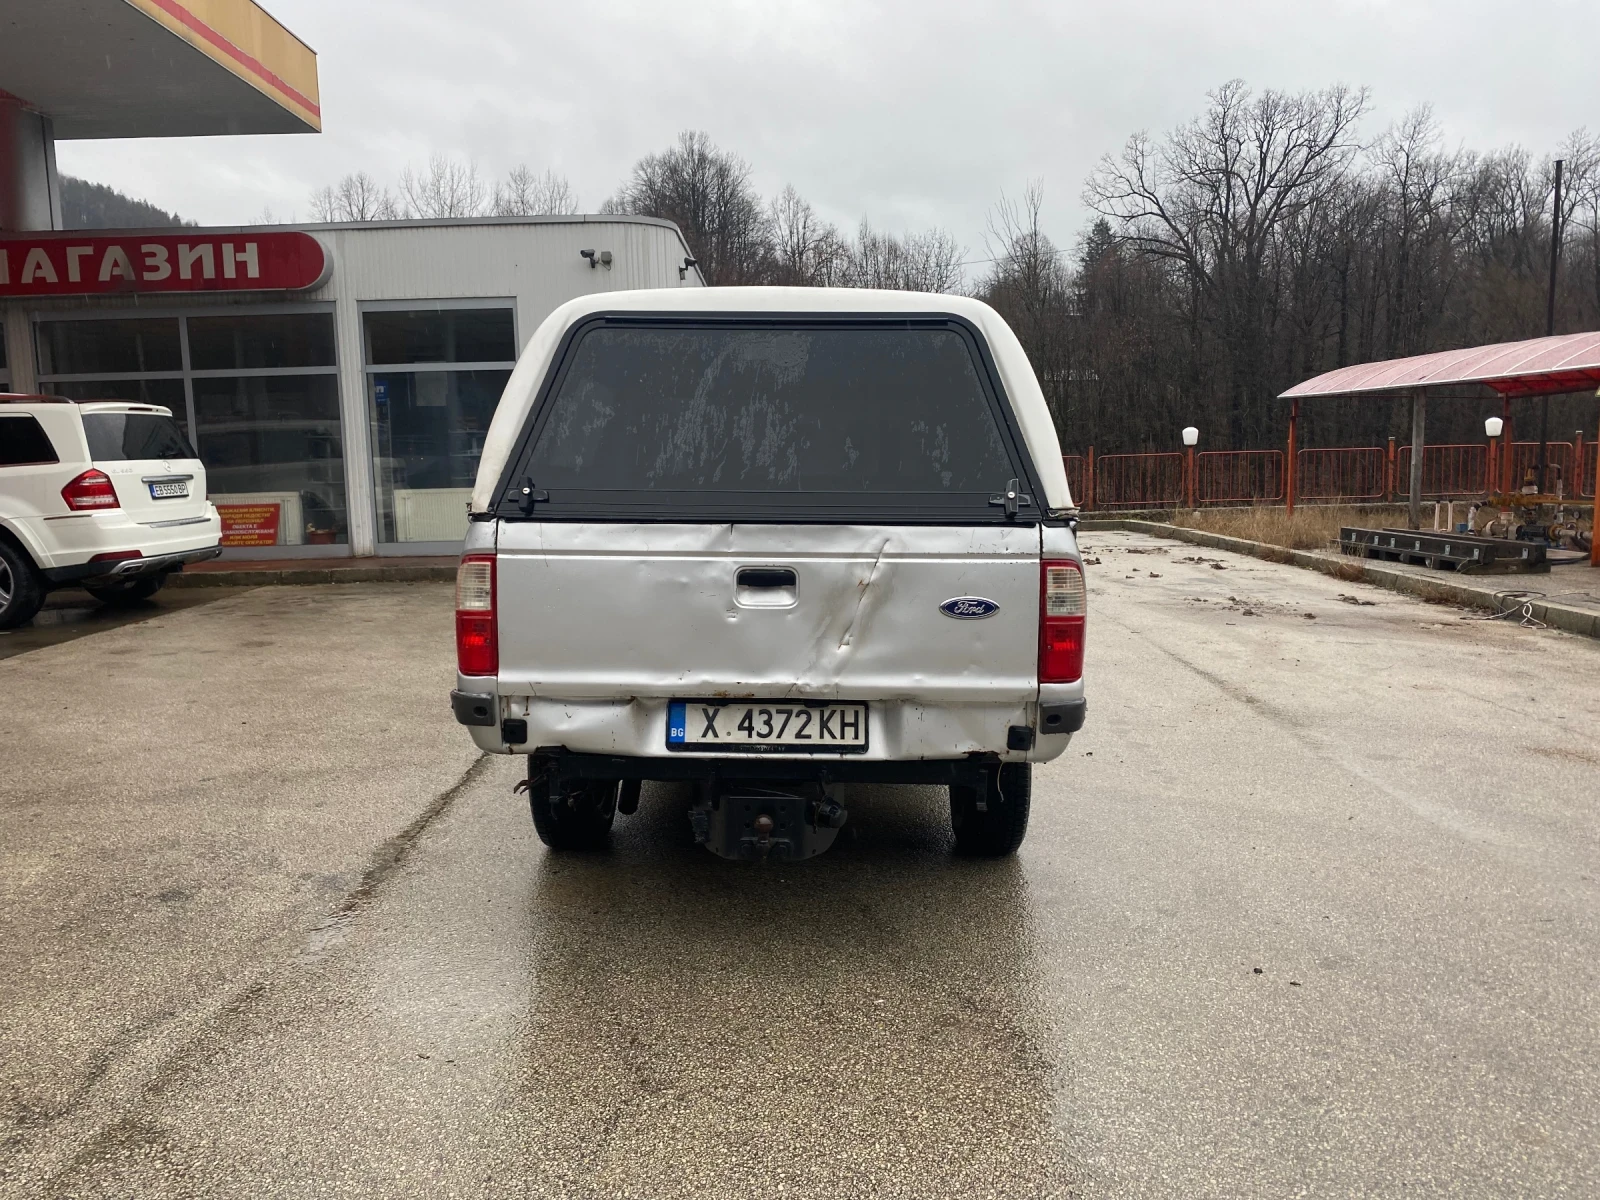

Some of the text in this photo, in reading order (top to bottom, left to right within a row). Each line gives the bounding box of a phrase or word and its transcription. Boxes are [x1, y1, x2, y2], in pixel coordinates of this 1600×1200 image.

[0, 242, 259, 285] АГАЗИН
[954, 600, 985, 614] Ford
[671, 728, 684, 737] BG
[701, 708, 859, 740] X 4372 KH
